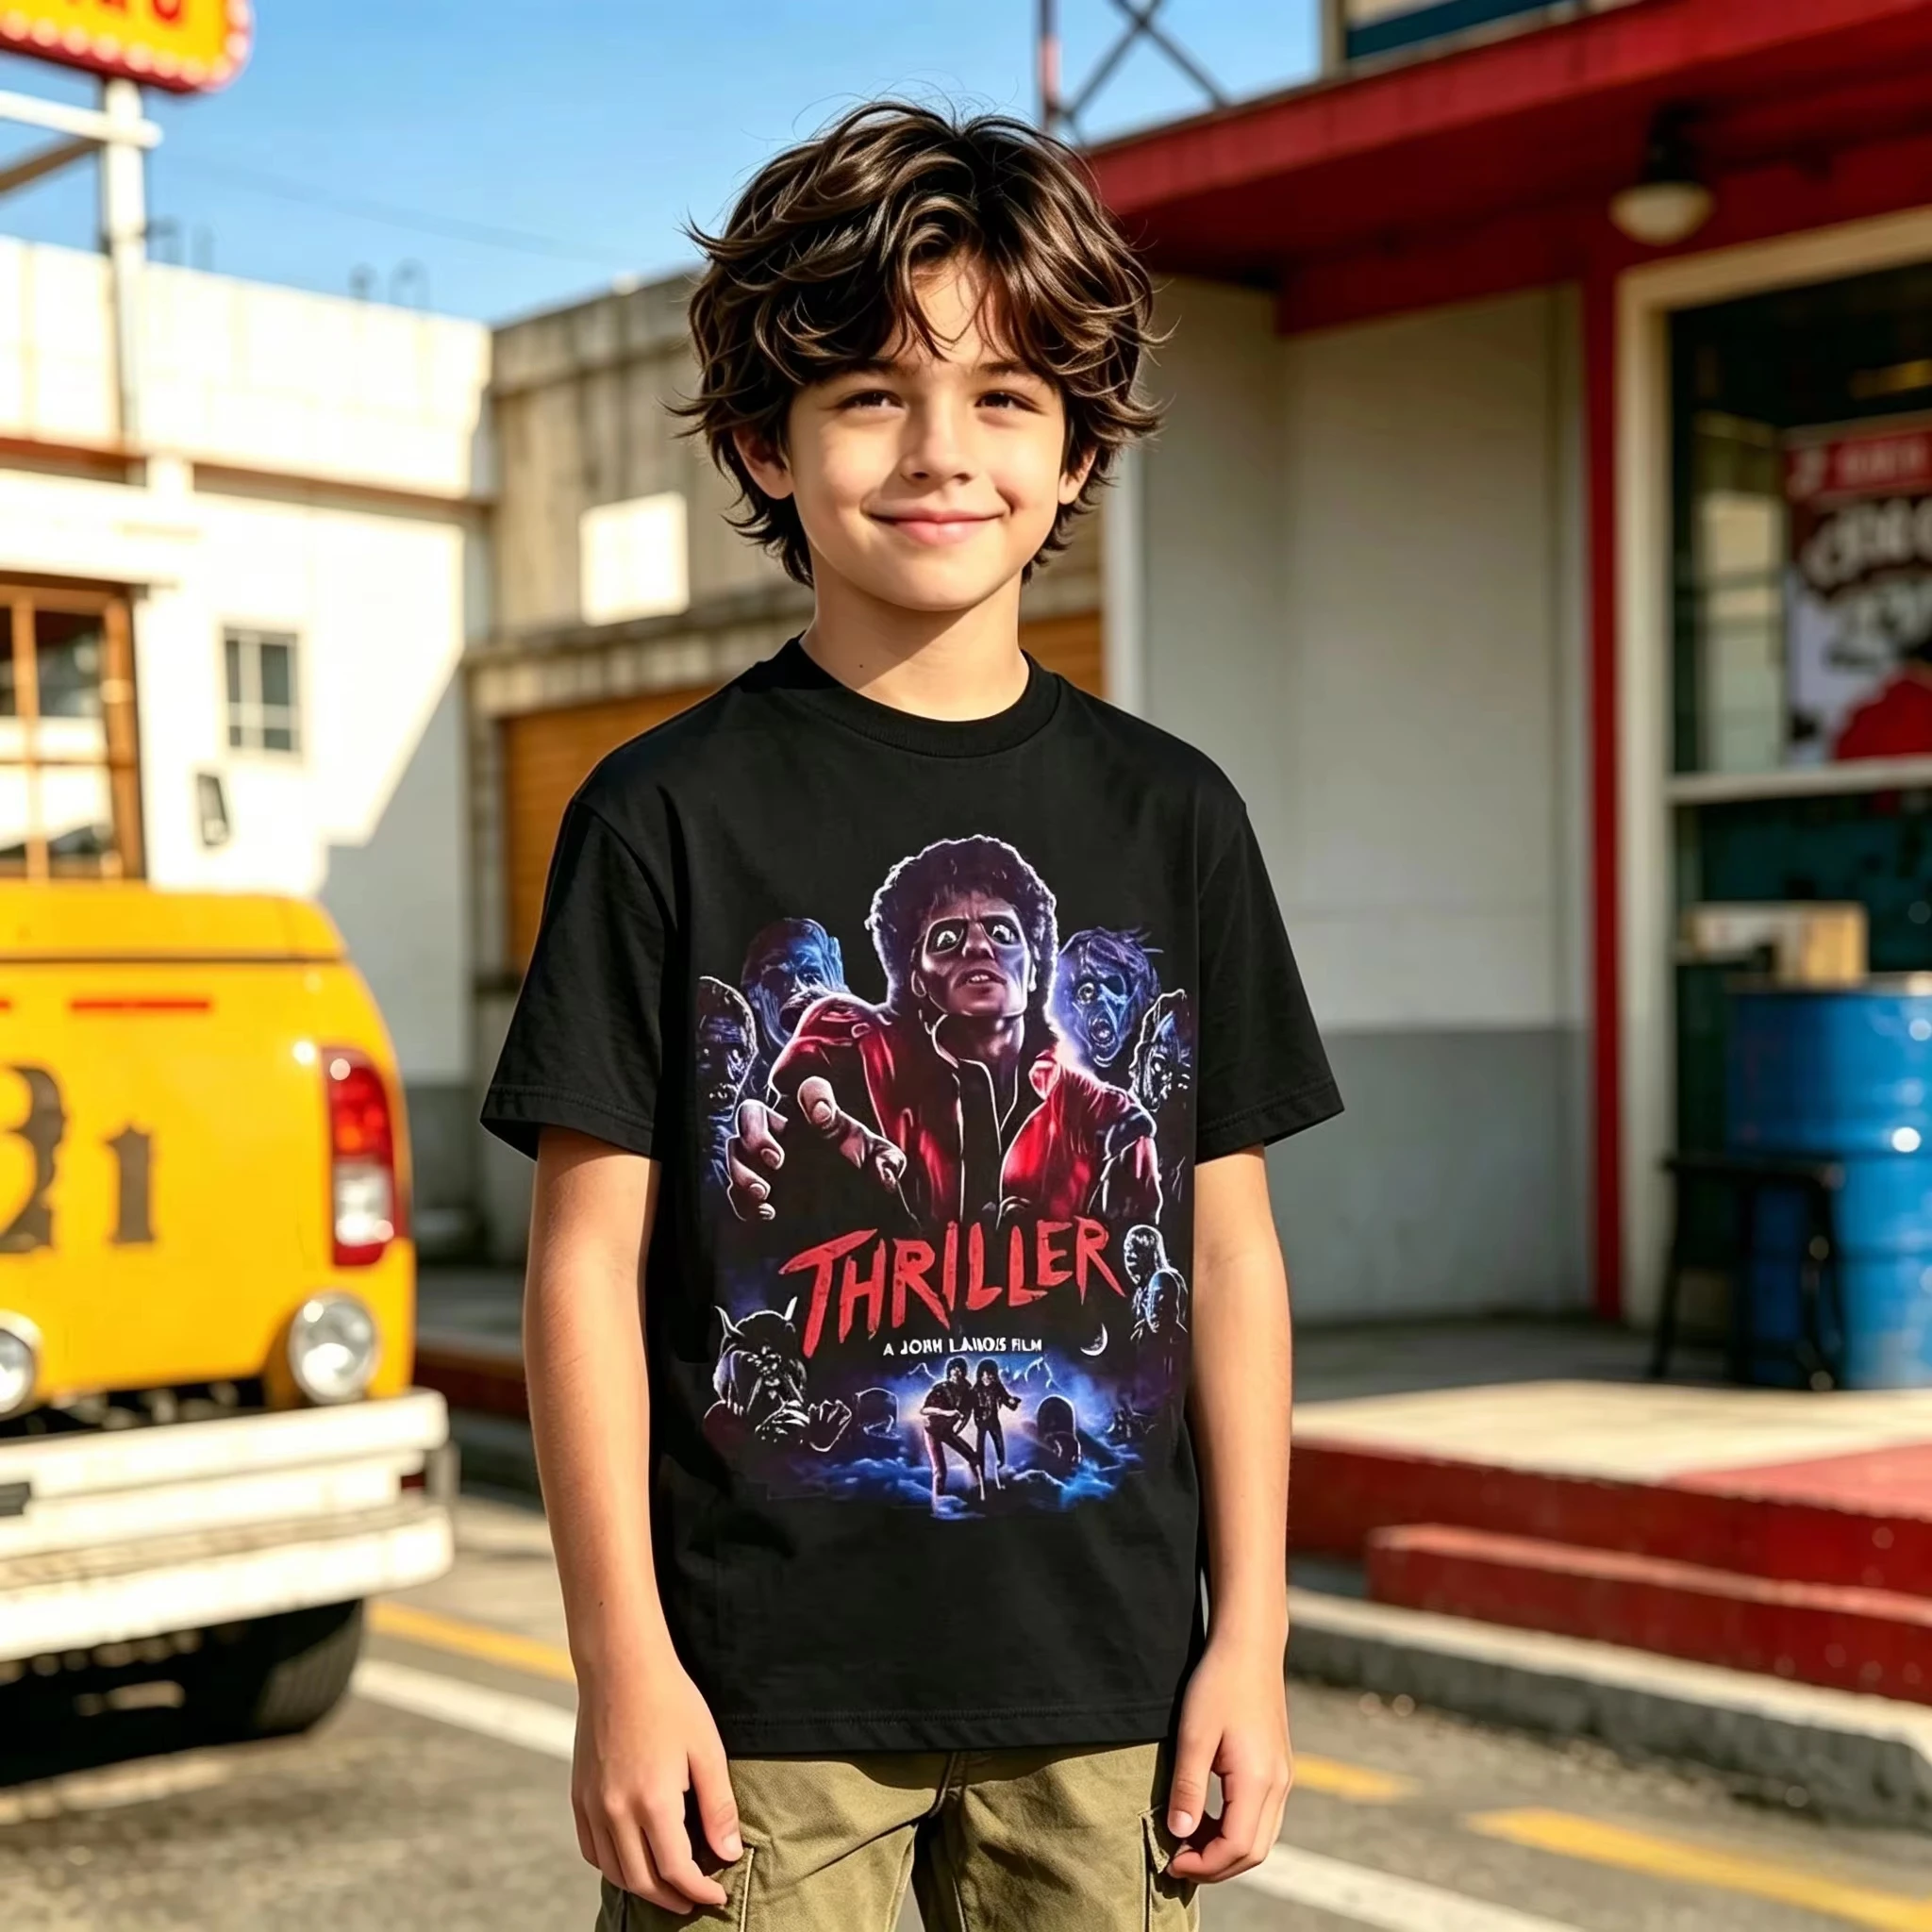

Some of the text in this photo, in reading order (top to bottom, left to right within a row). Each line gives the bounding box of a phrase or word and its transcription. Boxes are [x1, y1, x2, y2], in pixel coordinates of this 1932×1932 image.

[778, 1215, 1126, 1358] THRILLER
[882, 1342, 894, 1357] A
[1011, 1337, 1042, 1352] FILM
